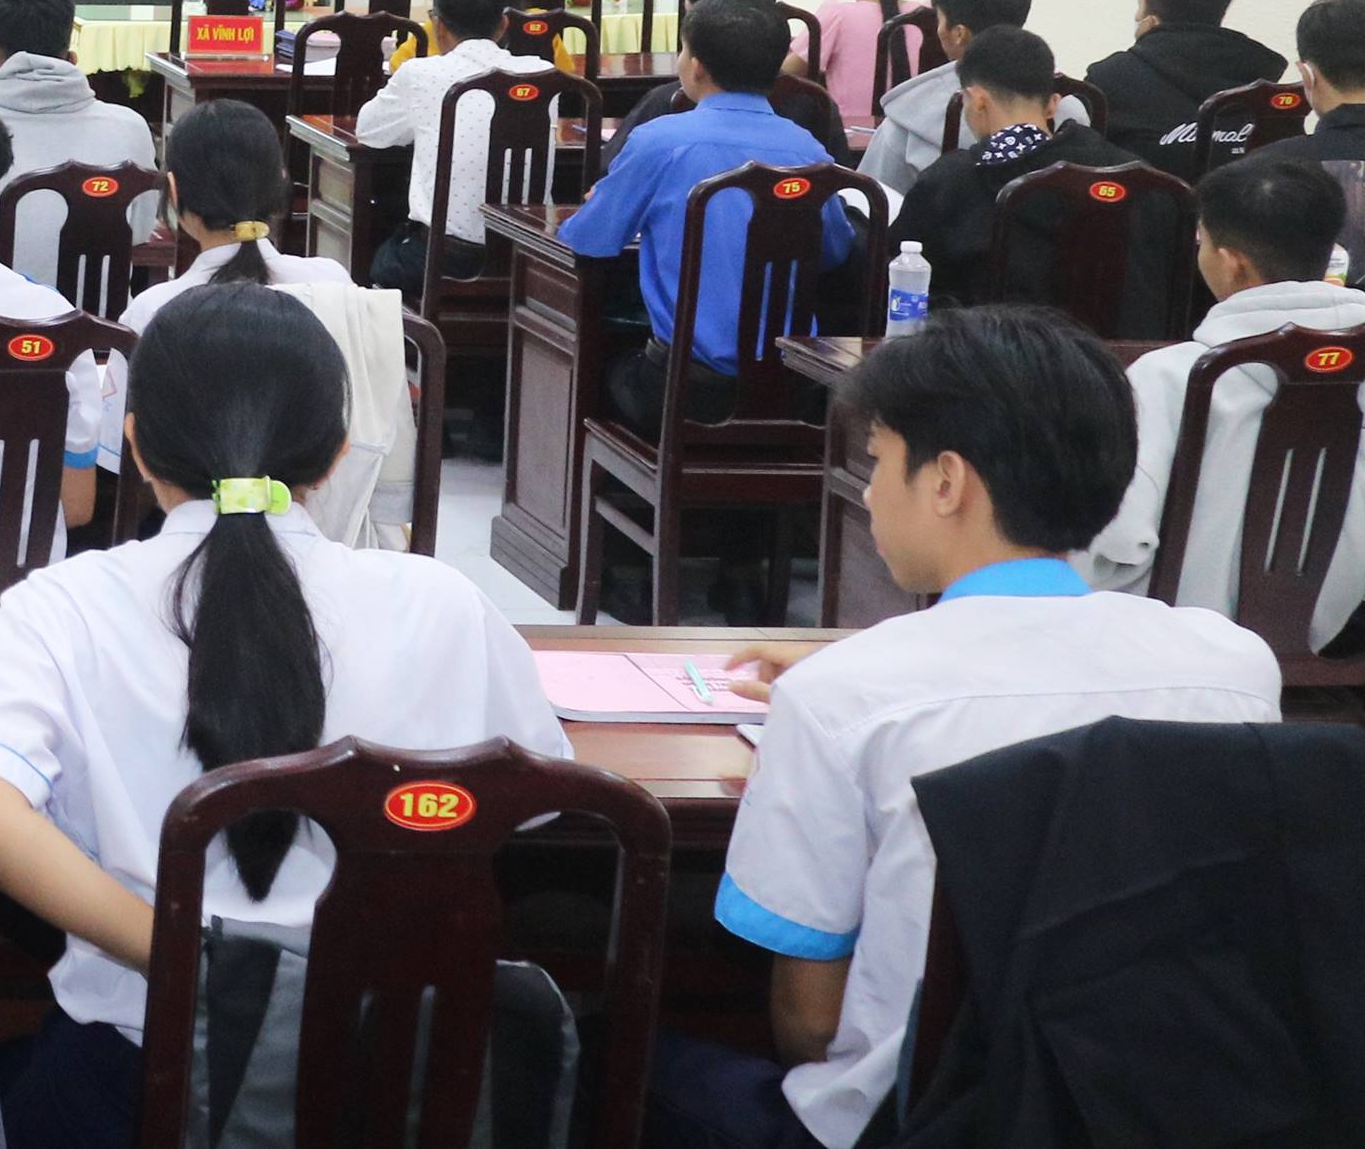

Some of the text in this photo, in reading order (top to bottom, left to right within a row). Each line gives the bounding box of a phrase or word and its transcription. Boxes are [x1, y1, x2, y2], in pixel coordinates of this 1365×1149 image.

[92, 180, 109, 192] 72
[783, 181, 800, 194] 75
[1099, 185, 1116, 197] 65
[21, 340, 41, 354] 51
[1318, 352, 1340, 366] 77
[400, 792, 459, 818] 162
